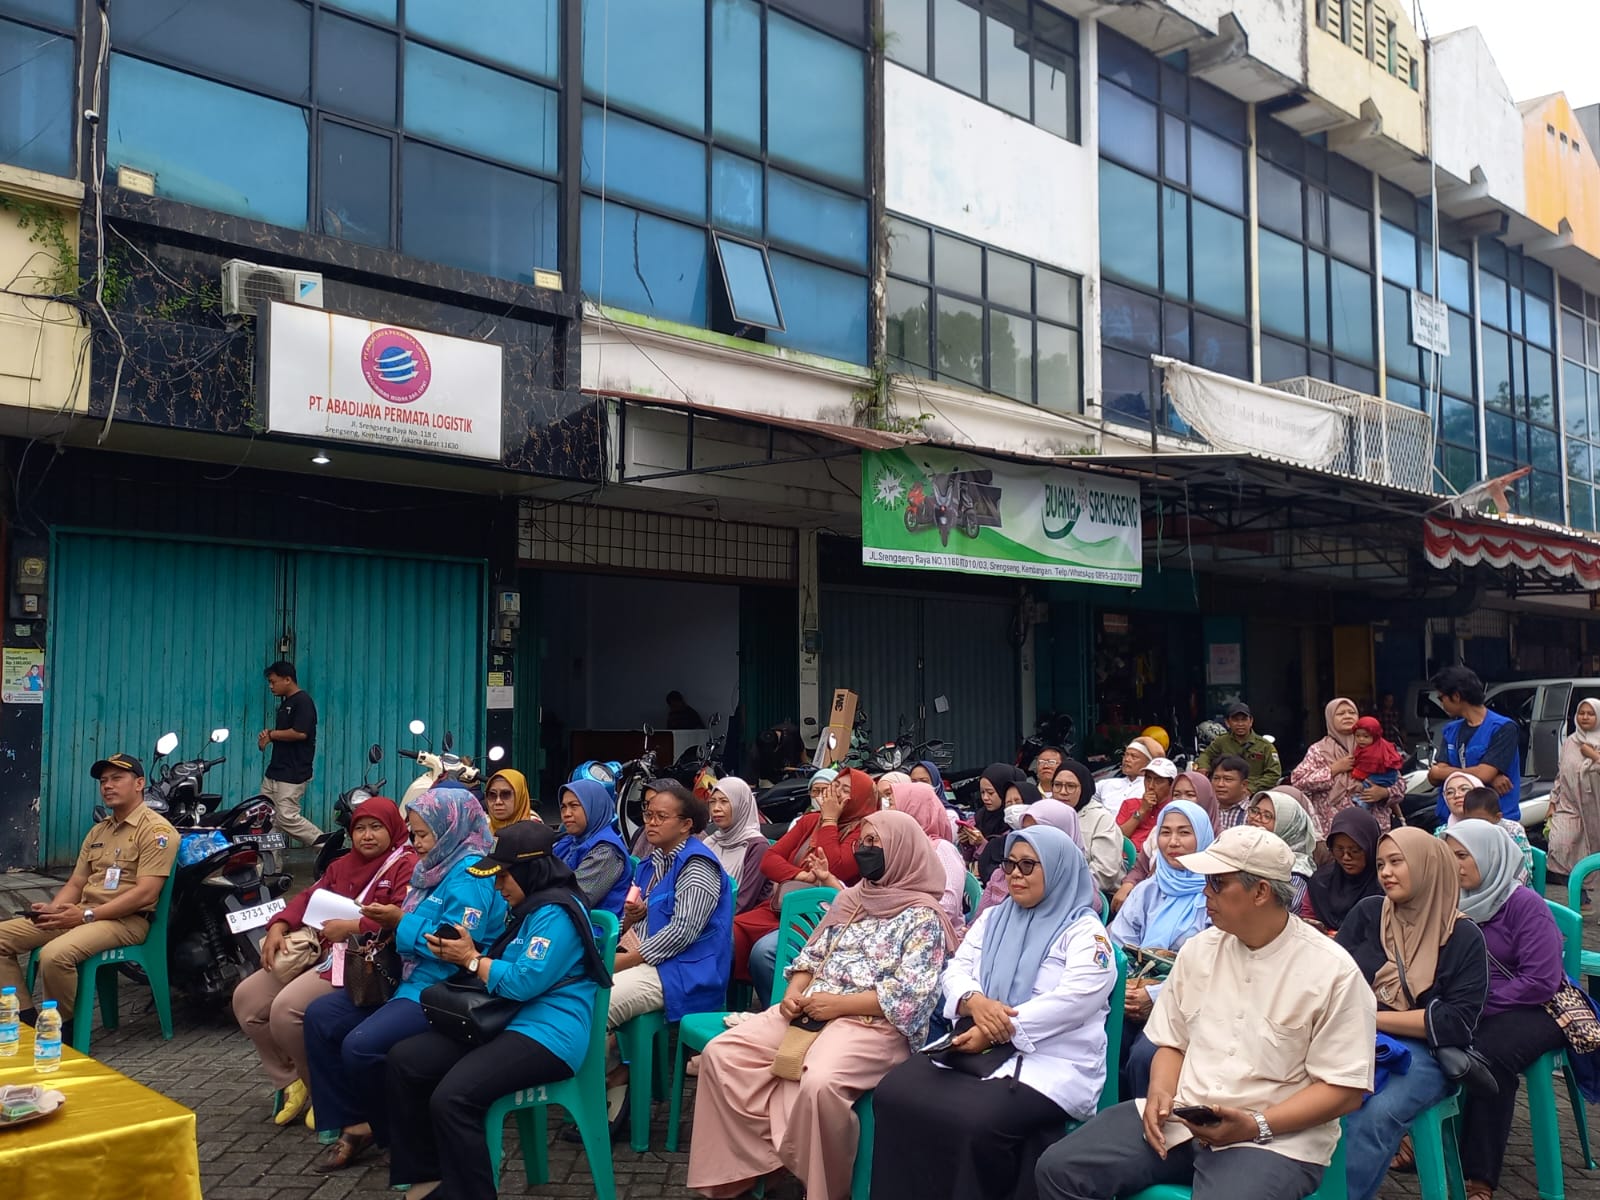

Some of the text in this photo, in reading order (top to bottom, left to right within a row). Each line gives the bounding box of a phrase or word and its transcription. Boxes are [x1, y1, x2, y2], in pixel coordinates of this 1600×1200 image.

[309, 395, 473, 434] PT. ABADIJAYA PERMATA LOGISTIK
[1045, 484, 1138, 528] BUANA SRENGSENG
[915, 555, 931, 566] Raya
[834, 694, 845, 712] 3M
[229, 915, 236, 924] B
[240, 907, 264, 921] 3731
